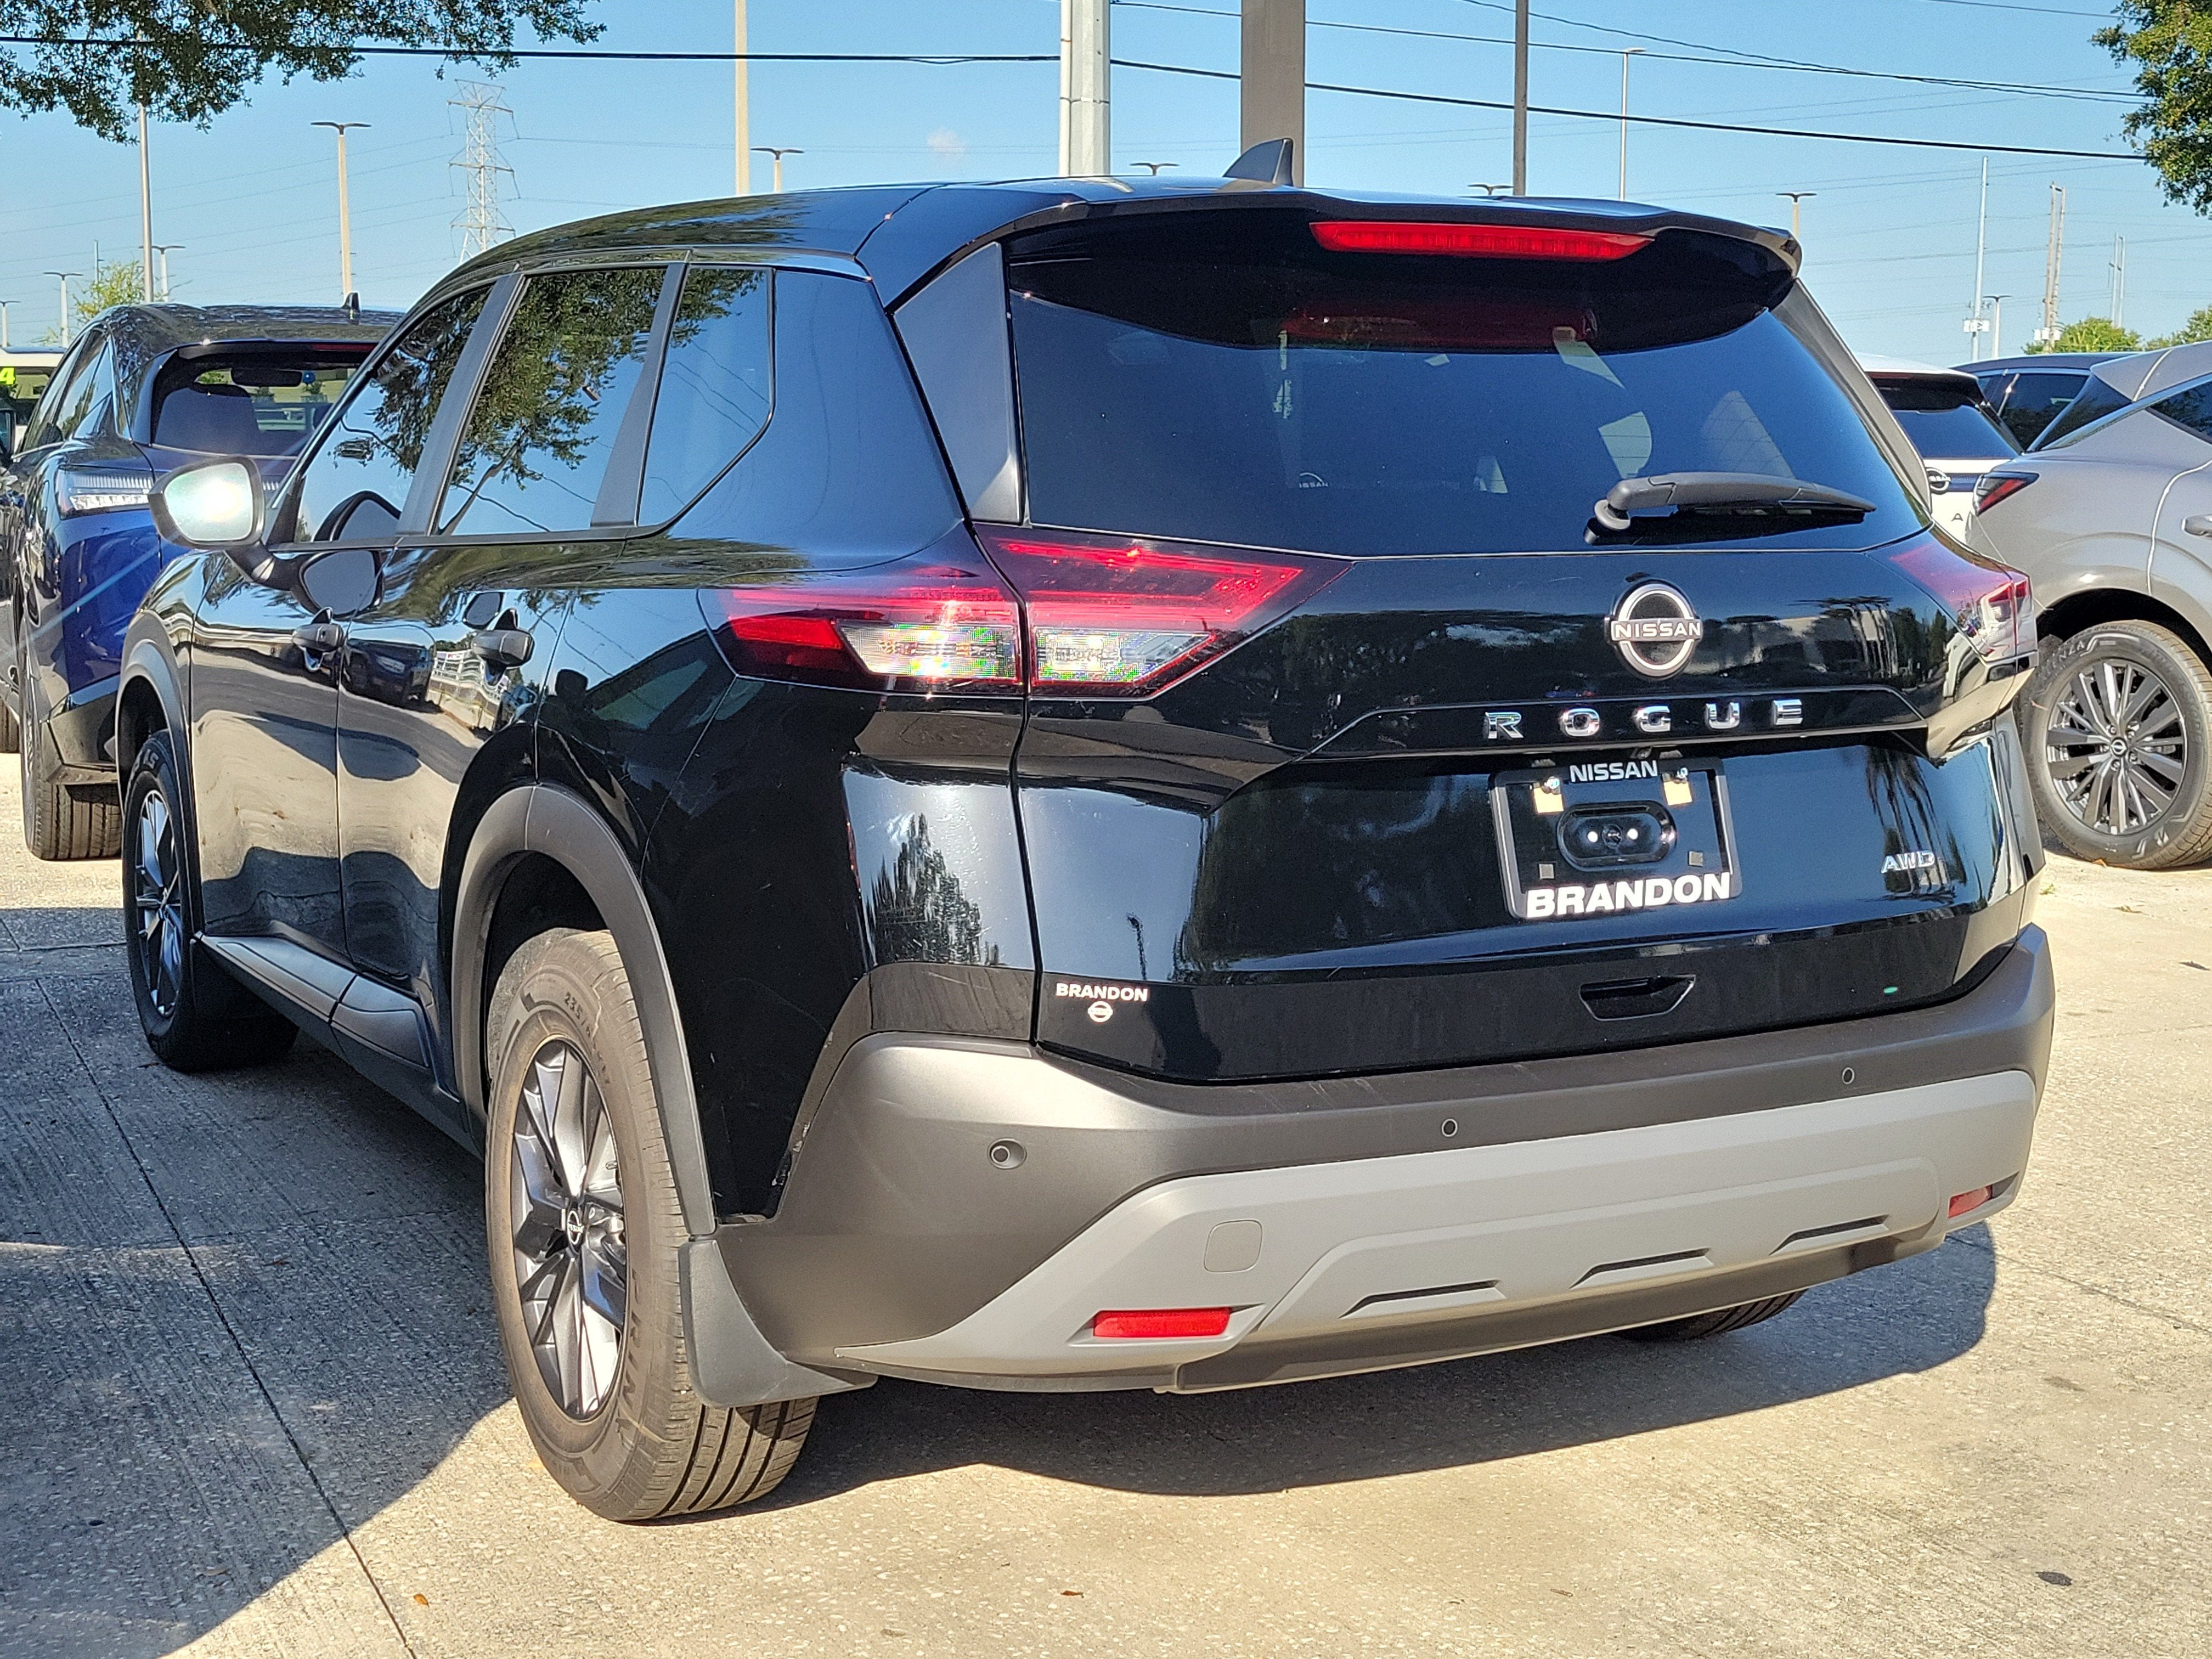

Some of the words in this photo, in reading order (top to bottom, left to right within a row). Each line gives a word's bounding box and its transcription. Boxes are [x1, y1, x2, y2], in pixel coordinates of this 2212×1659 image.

[1615, 622, 1701, 639] NISSAN
[1484, 698, 1804, 740] ROGUE
[1569, 760, 1658, 782] NISSAN
[1881, 850, 1936, 874] AWD
[1526, 871, 1731, 918] BRANDON
[1056, 983, 1148, 1002] BRANDON
